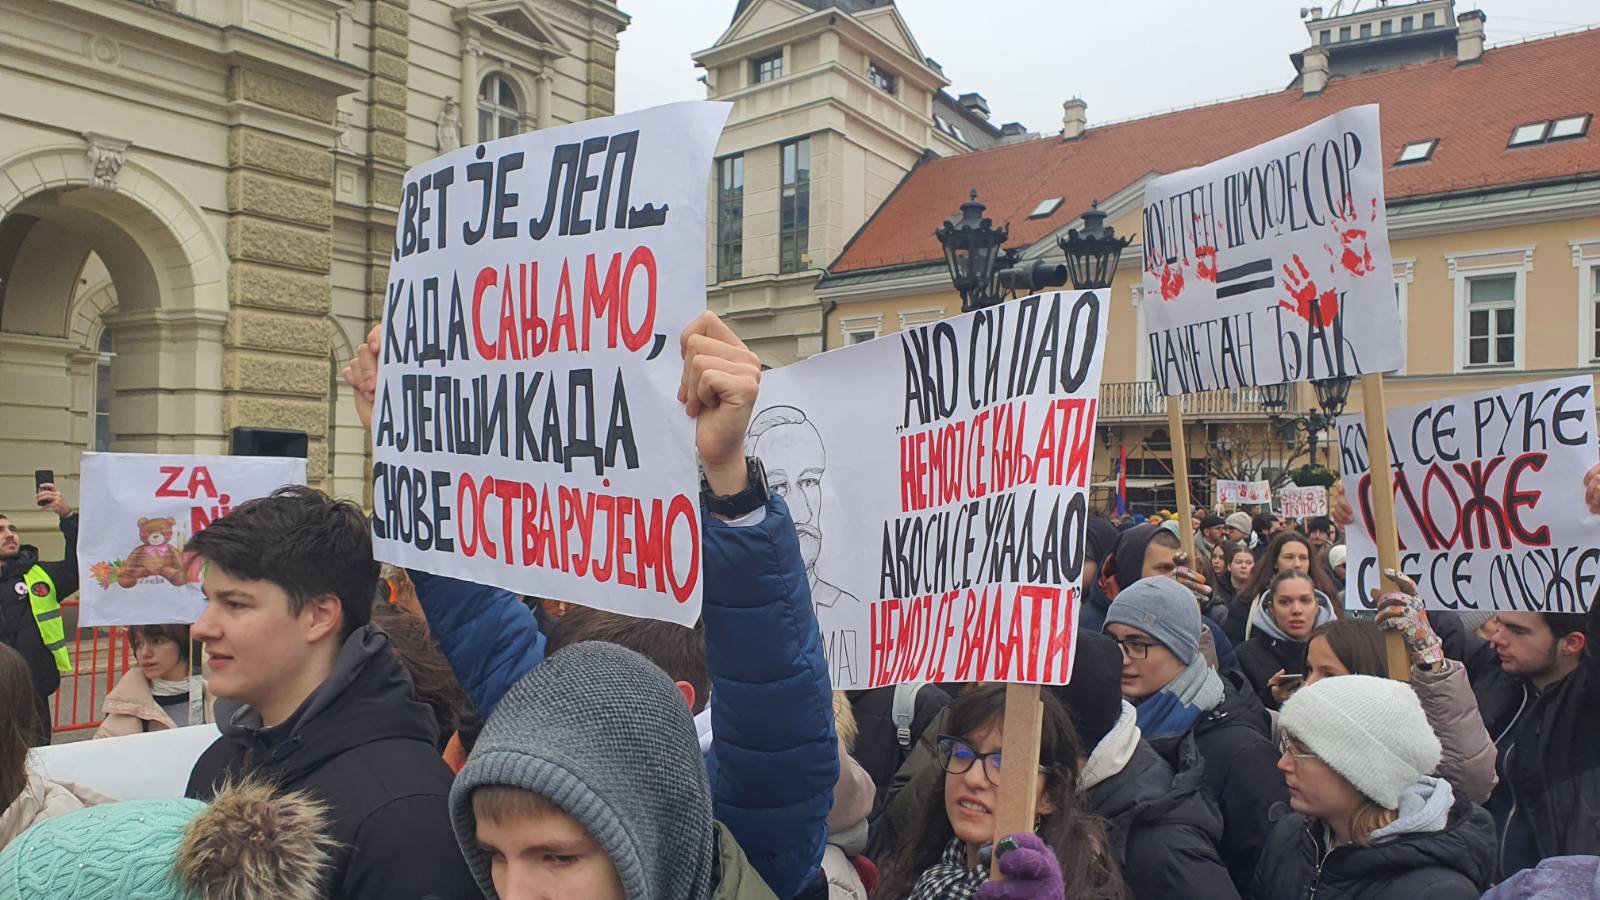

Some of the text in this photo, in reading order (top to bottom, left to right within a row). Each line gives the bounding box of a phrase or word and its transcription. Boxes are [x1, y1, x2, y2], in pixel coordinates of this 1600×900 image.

[462, 144, 524, 245] ЈЕ
[1224, 132, 1362, 249] ПРОФЕСОР
[384, 269, 470, 368] КАДА
[968, 304, 1005, 410] СИ
[1006, 291, 1100, 400] ПАО
[1149, 291, 1363, 397] ПАМЕТАН ЂАК
[376, 366, 640, 476] А ЛЕПШИ КАДА
[900, 398, 1097, 512] НЕМОЈ СЕ КАЉАТИ
[1411, 404, 1460, 465] СЕ
[1474, 385, 1591, 458] РУКЕ
[155, 466, 218, 499] ZA
[373, 461, 700, 603] СНОВЕ ОСТВАРУЈЕМО
[880, 516, 923, 599] АКО
[923, 511, 950, 594] СИ
[951, 501, 980, 590] СЕ
[1430, 552, 1479, 609] СЕ
[1489, 546, 1600, 613] МОЖЕ
[868, 594, 934, 688] НЕМОЈ
[925, 590, 960, 683] СЕ
